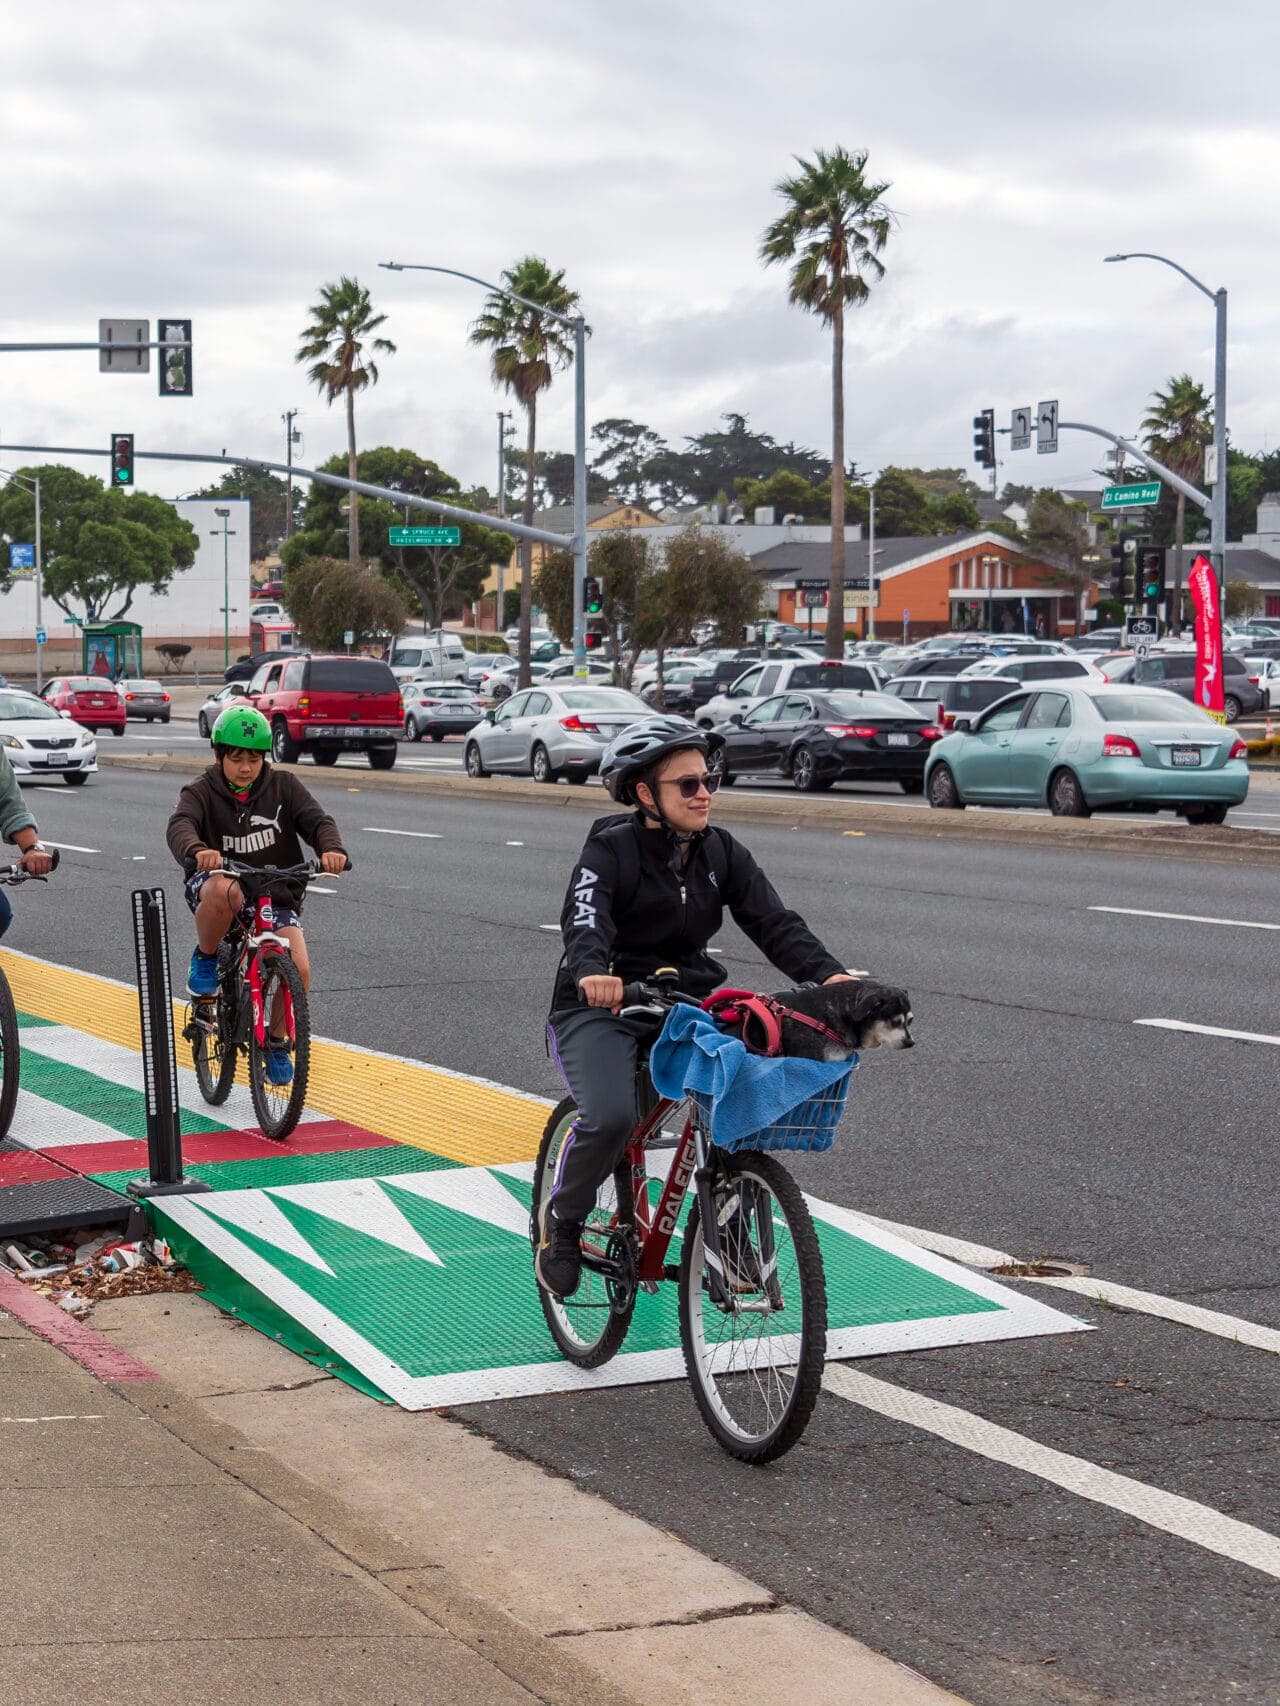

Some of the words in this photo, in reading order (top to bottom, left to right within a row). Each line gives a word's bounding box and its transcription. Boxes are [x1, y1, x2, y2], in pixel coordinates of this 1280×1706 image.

[1105, 493, 1113, 502] El
[1115, 490, 1139, 501] Camino
[1142, 488, 1157, 498] Real
[222, 827, 276, 854] PUMA
[573, 867, 599, 928] AFAT
[658, 1130, 697, 1236] RALEIG
